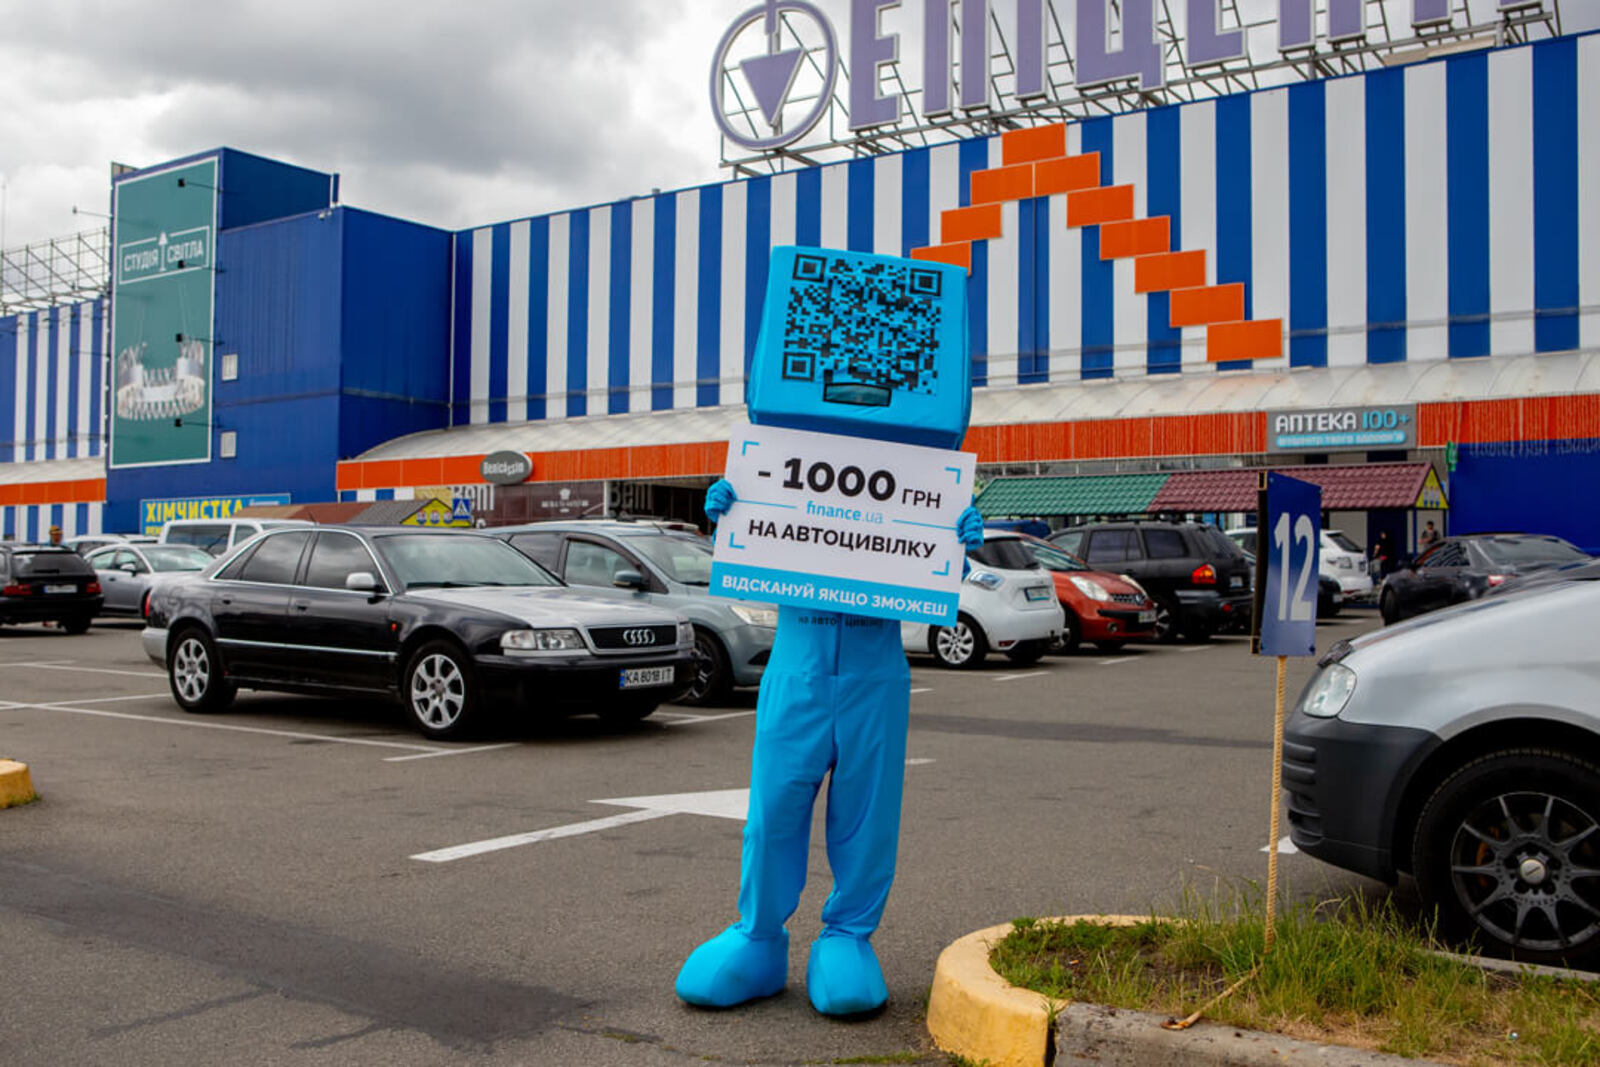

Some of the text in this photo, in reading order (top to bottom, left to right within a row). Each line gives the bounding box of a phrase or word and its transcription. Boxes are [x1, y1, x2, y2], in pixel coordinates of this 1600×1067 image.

[123, 240, 204, 273] СТУДІЯ СВІТЛА
[1275, 411, 1357, 433] АПТЕКА
[783, 457, 896, 502] 1000
[902, 488, 941, 509] ГРН
[806, 500, 884, 524] finance.ua
[748, 519, 937, 559] НА АВТОЦИВІЛКУ
[1274, 512, 1315, 622] 12
[722, 574, 949, 618] ВІДСКАНУЙ ЯКЩО ЗМОЖЕШ
